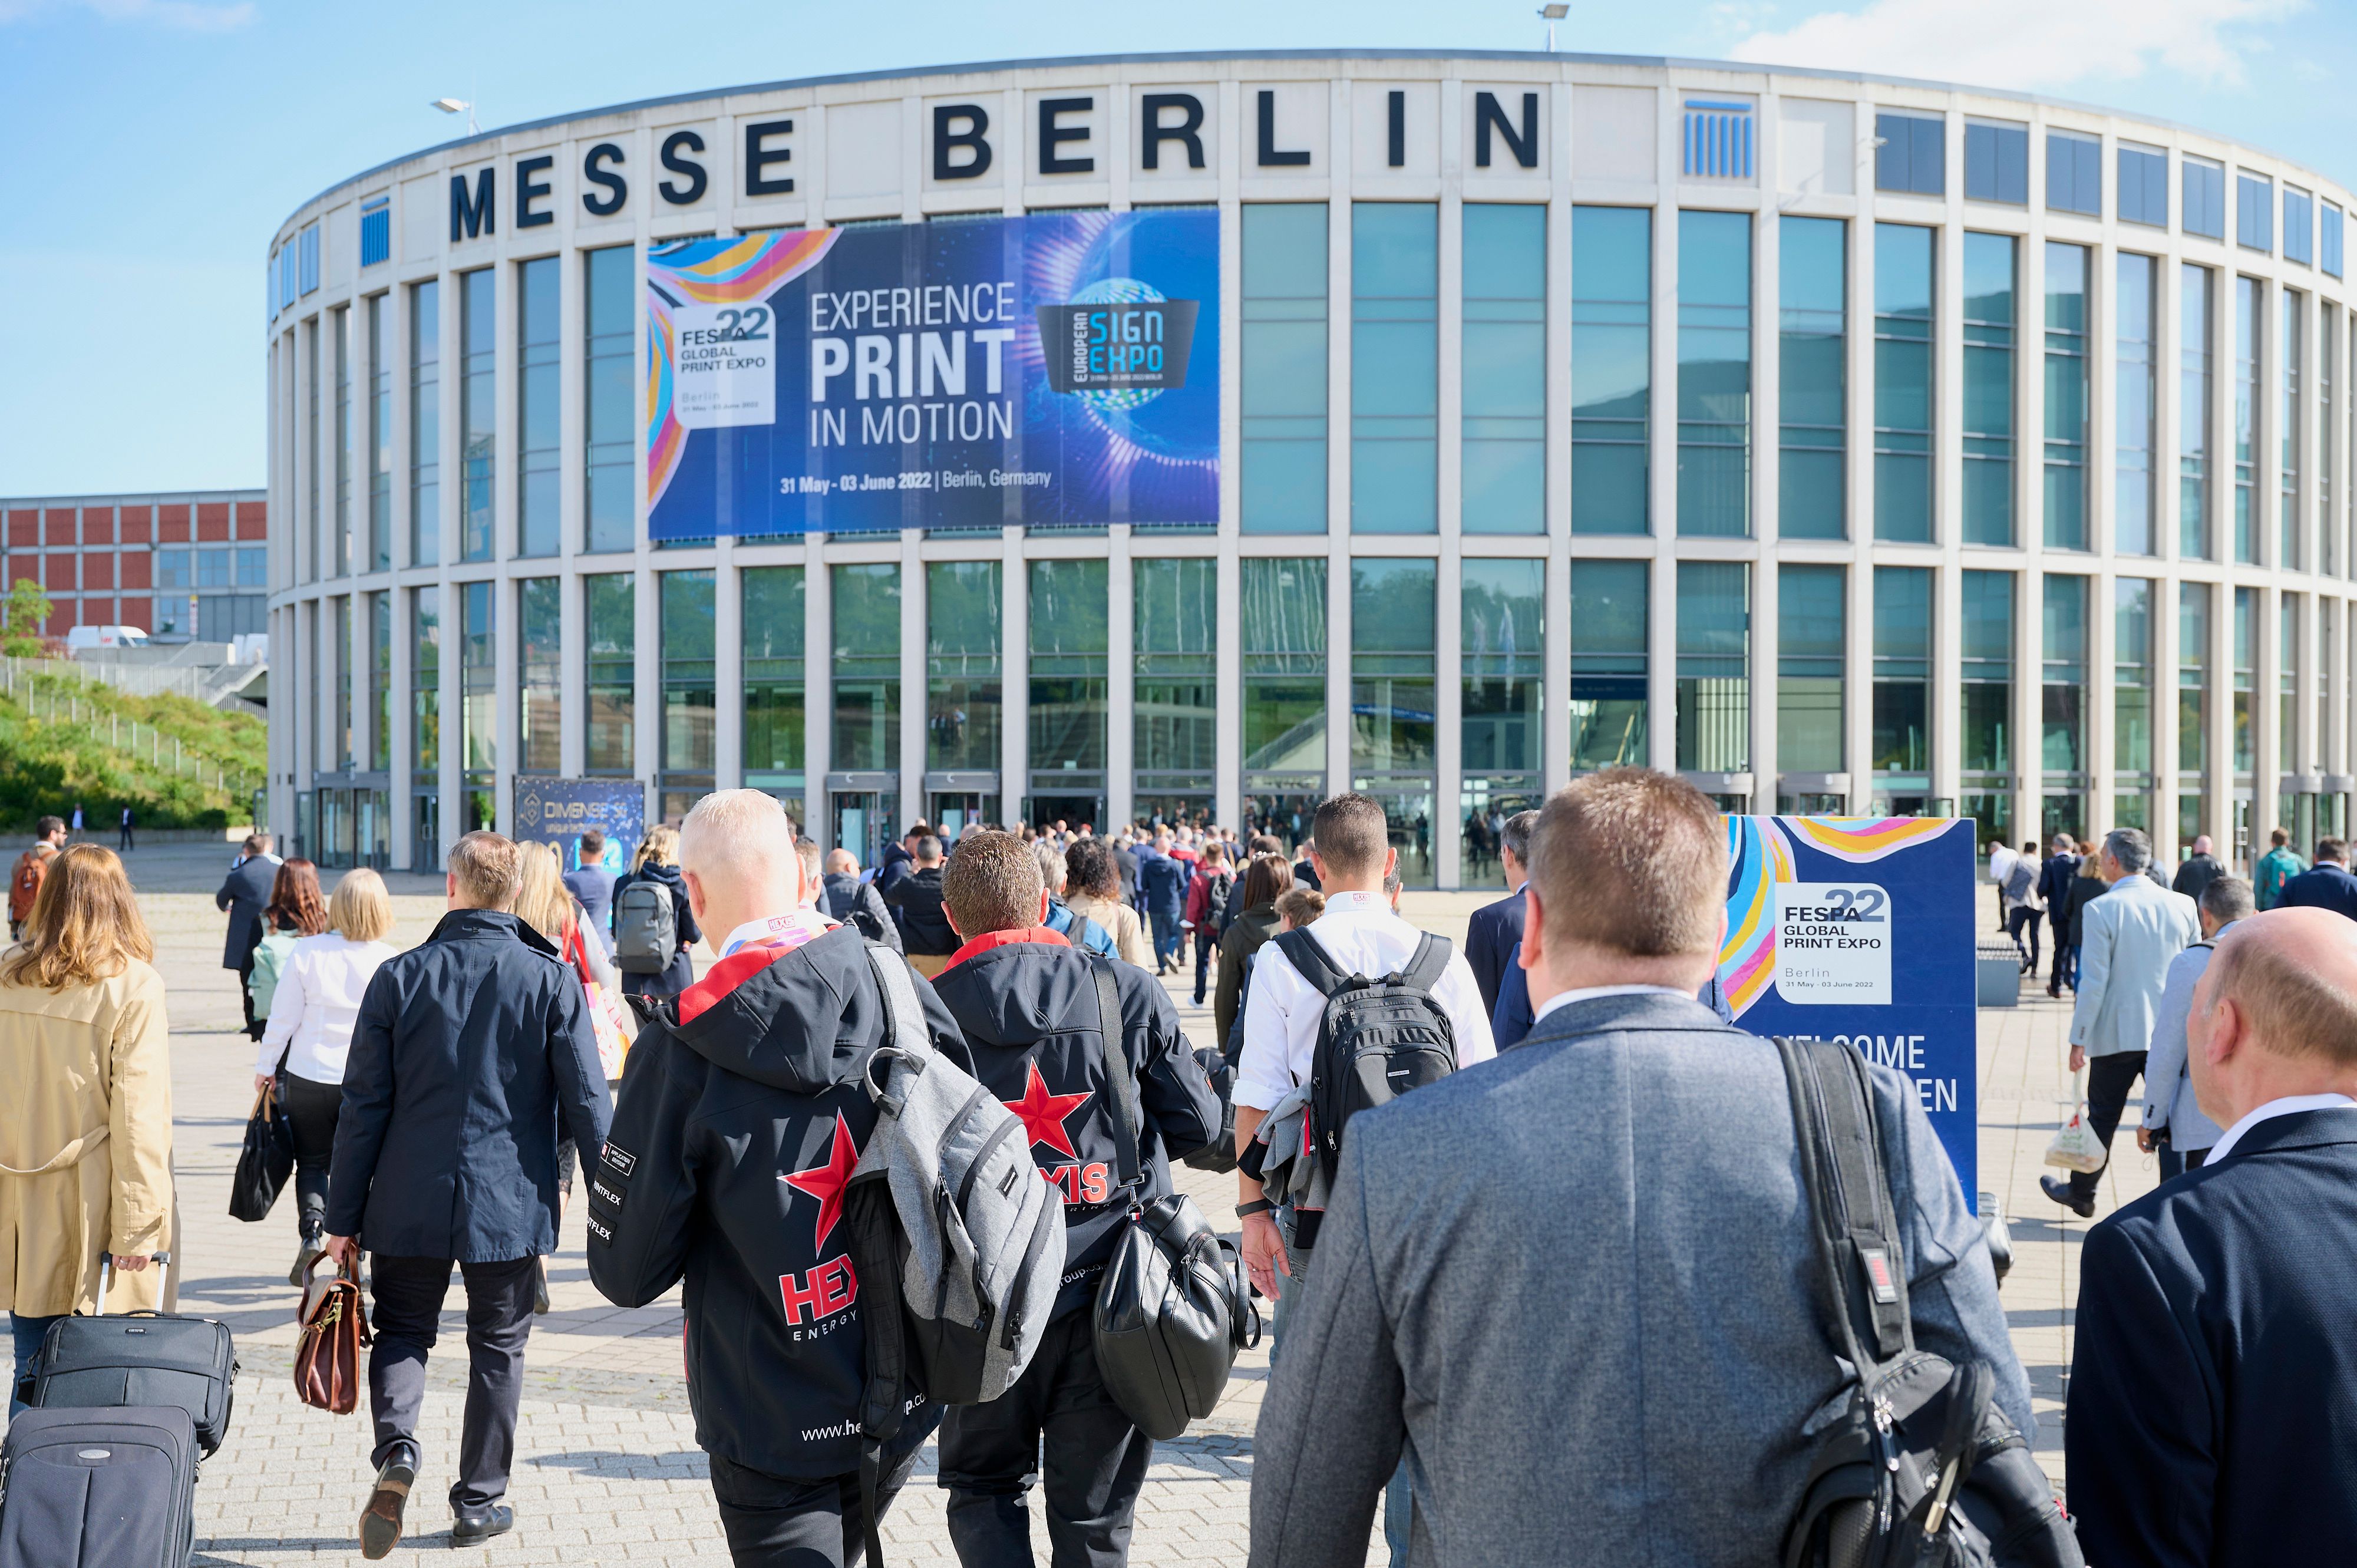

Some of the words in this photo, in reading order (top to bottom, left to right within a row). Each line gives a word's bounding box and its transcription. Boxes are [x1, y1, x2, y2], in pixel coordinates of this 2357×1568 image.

[451, 120, 794, 242] MESSE
[933, 90, 1538, 180] BERLIN
[811, 282, 1015, 332] EXPERIENCE
[716, 308, 769, 342] 22
[682, 328, 748, 346] FESPA
[681, 346, 737, 361] GLOBAL
[1090, 345, 1163, 373] EXPO
[681, 360, 723, 373] PRINT
[727, 357, 765, 370] EXPO
[811, 328, 1015, 402] PRINT
[682, 391, 720, 403] Berlin
[811, 408, 846, 448] IN
[862, 401, 1012, 445] MOTION
[780, 478, 795, 494] 31
[799, 476, 829, 496] May
[840, 474, 857, 491] 03
[859, 473, 895, 490] June
[898, 471, 932, 489] 2022
[943, 470, 986, 488] Berlin,
[989, 468, 1052, 488] Germany
[1785, 907, 1862, 922] FESPA
[1825, 889, 1884, 922] 22
[768, 915, 795, 932] HEXIS
[1784, 925, 1849, 936] GLOBAL
[1784, 938, 1833, 948] PRINT
[1838, 938, 1881, 949] EXPO
[1785, 968, 1830, 978] Berlin
[610, 1149, 631, 1164] APPLICATION
[793, 1309, 856, 1342] ENERGY
